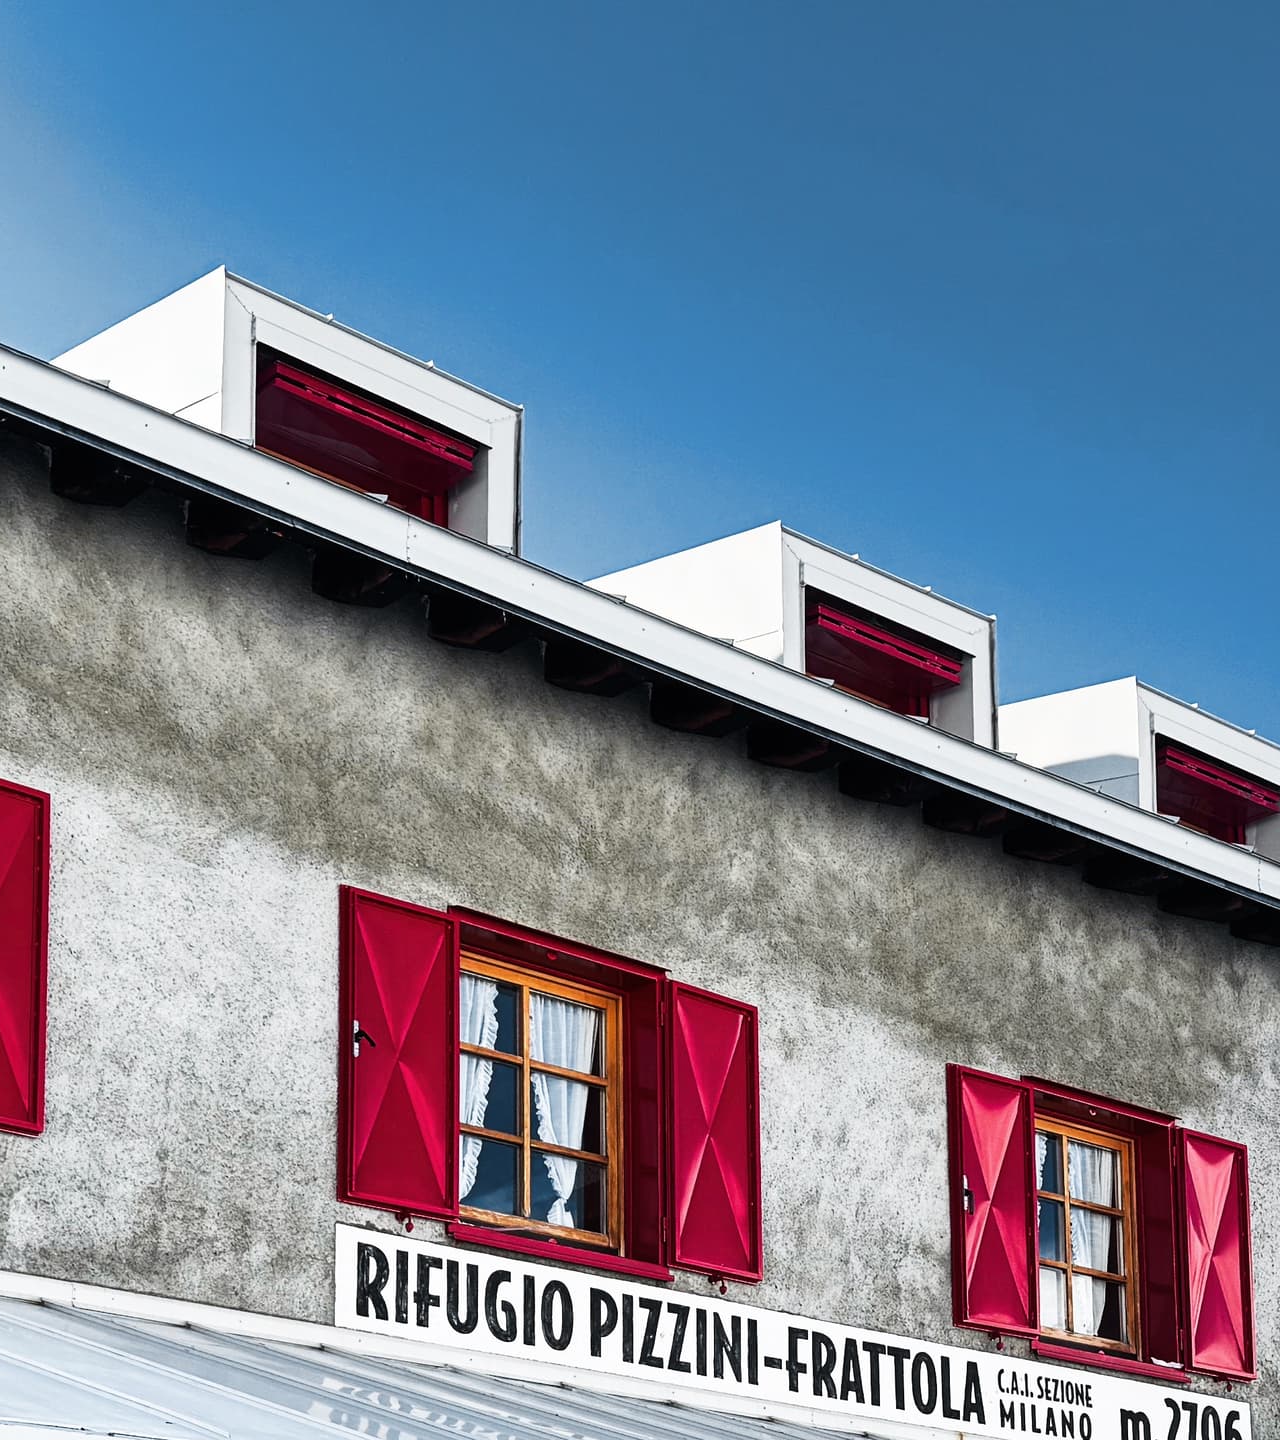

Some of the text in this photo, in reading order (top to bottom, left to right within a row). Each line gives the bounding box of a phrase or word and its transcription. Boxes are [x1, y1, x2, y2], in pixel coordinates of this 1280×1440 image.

[356, 1241, 986, 1425] RIFUGIO PIZZINI-FRATTOLA
[997, 1368, 1093, 1409] C.A.I. SEZIONE
[999, 1399, 1093, 1440] MILANO
